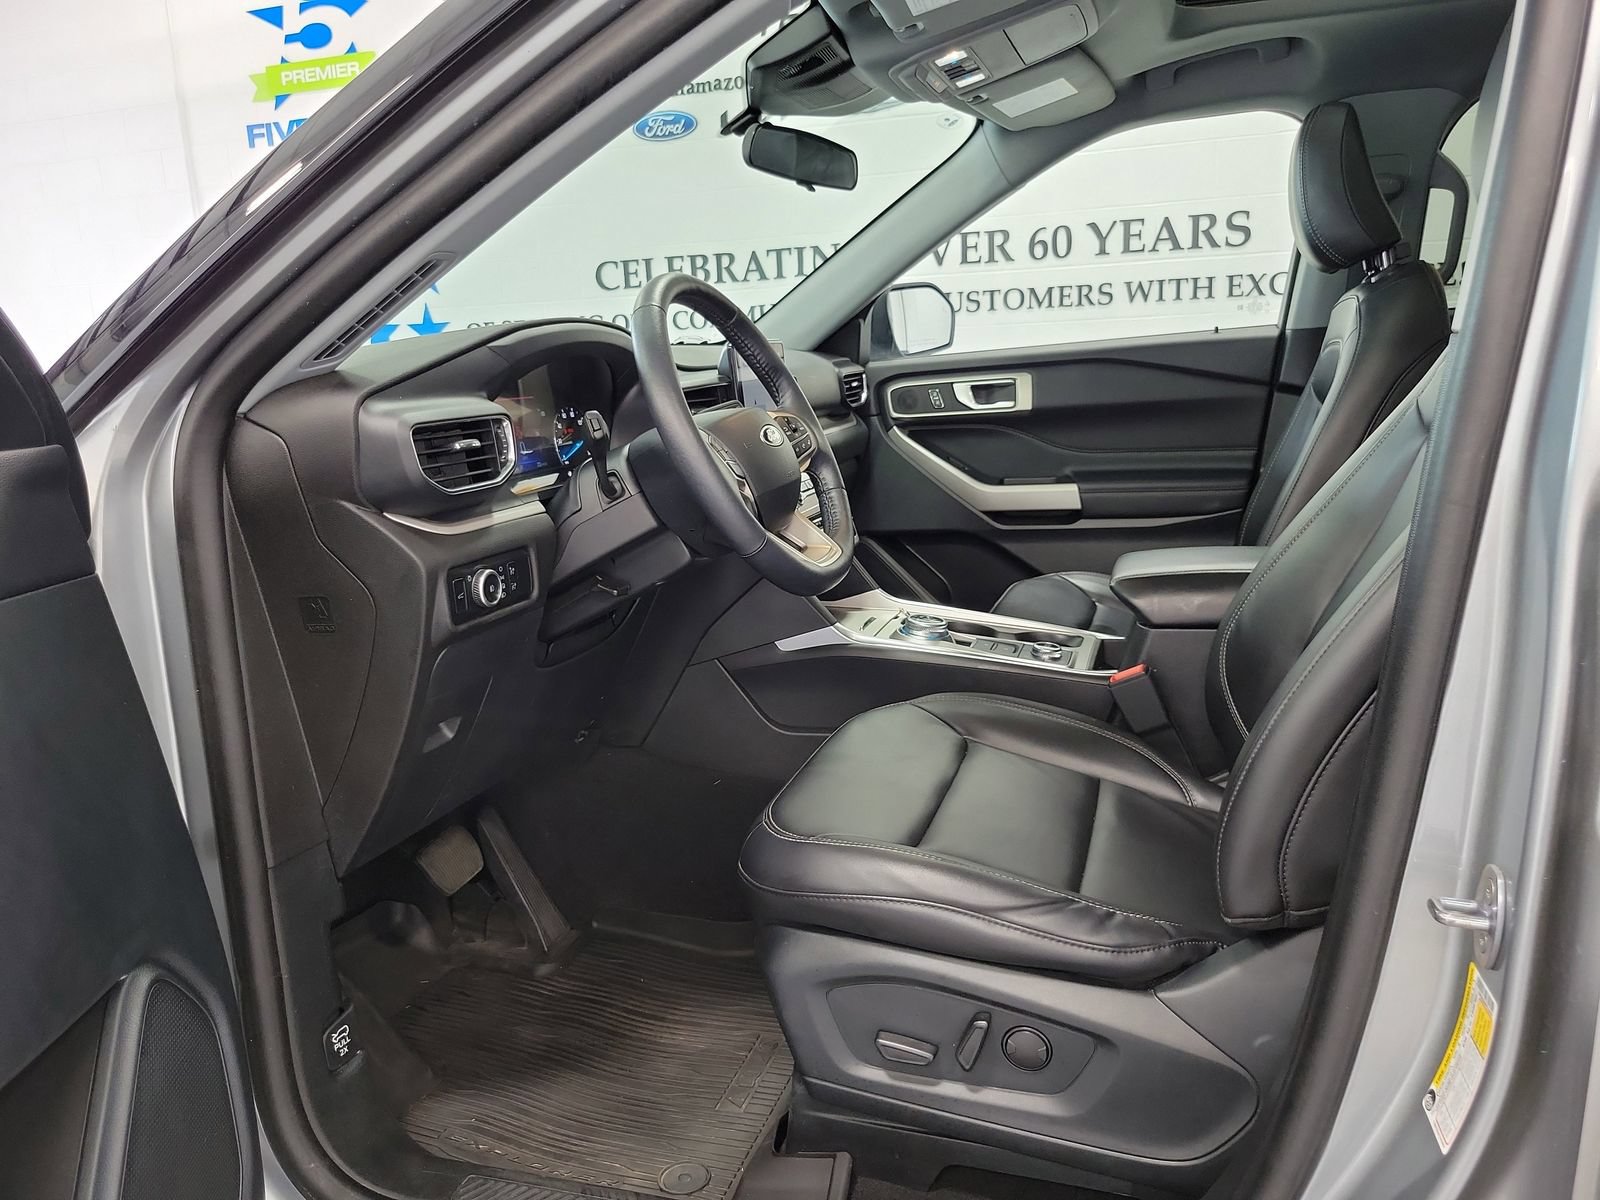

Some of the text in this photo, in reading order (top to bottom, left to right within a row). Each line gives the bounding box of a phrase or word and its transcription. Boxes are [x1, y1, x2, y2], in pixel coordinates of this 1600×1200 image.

[280, 61, 360, 86] PREMIER
[644, 115, 686, 137] Ford
[1029, 225, 1073, 260] 60
[1086, 210, 1252, 256] YEARS
[1124, 276, 1216, 304] WITH
[334, 1036, 351, 1052] PULL
[339, 1046, 349, 1057] 2X
